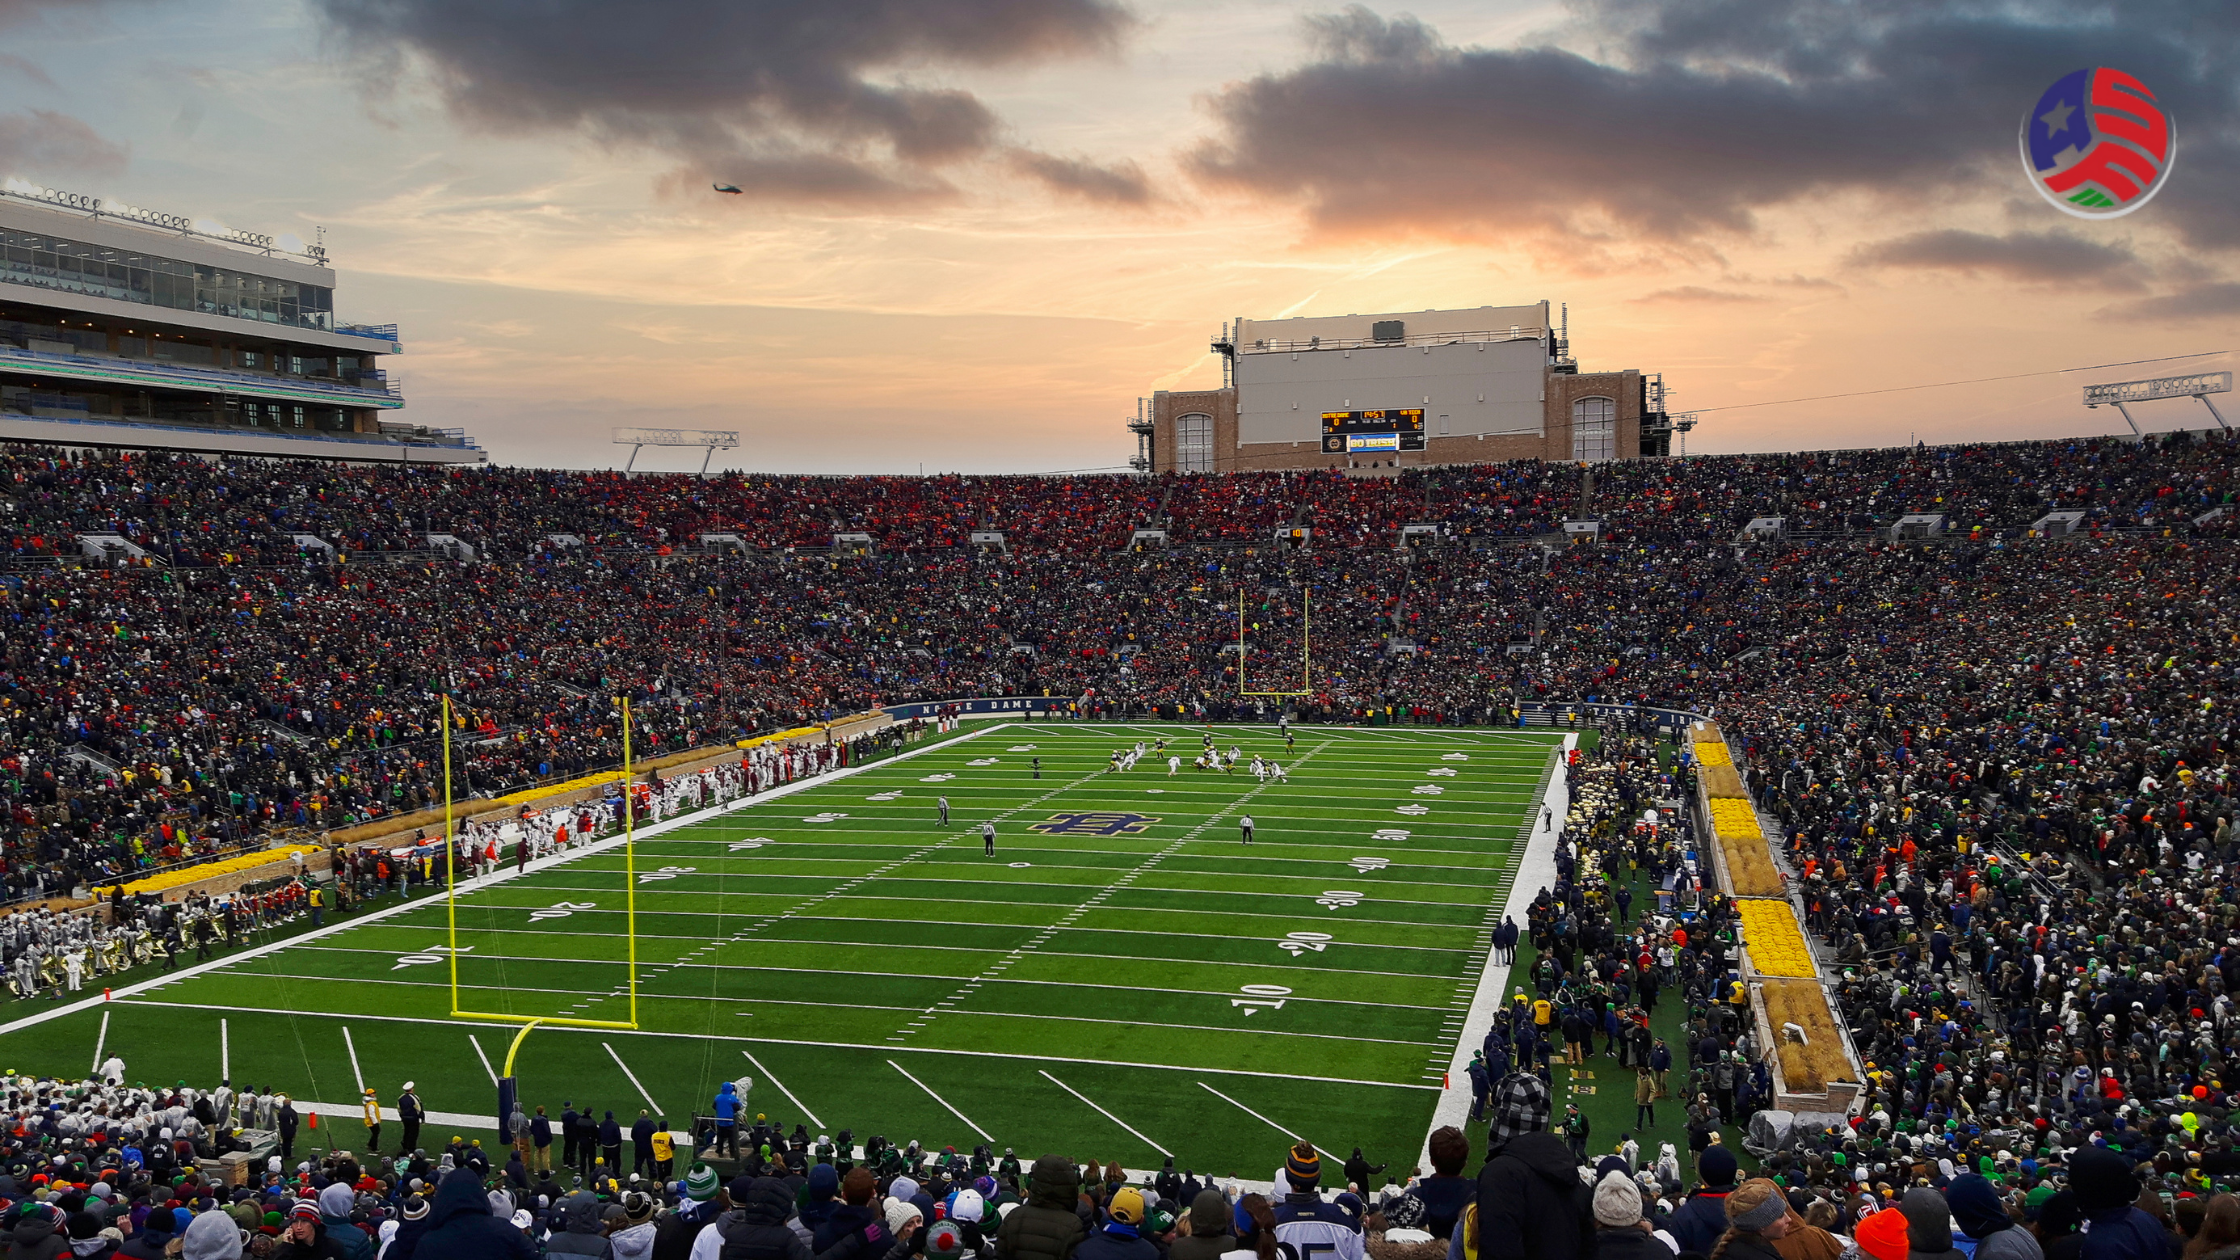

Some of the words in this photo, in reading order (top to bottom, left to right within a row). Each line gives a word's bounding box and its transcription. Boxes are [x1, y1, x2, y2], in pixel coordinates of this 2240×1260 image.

[1363, 410, 1385, 418] 14:57
[1292, 529, 1301, 537] 10
[991, 700, 1032, 710] DAME
[638, 866, 697, 881] 30
[1315, 890, 1364, 907] 30
[530, 901, 597, 918] 20
[1278, 931, 1333, 952] 20
[397, 944, 475, 964] 10
[1231, 984, 1293, 1010] 10
